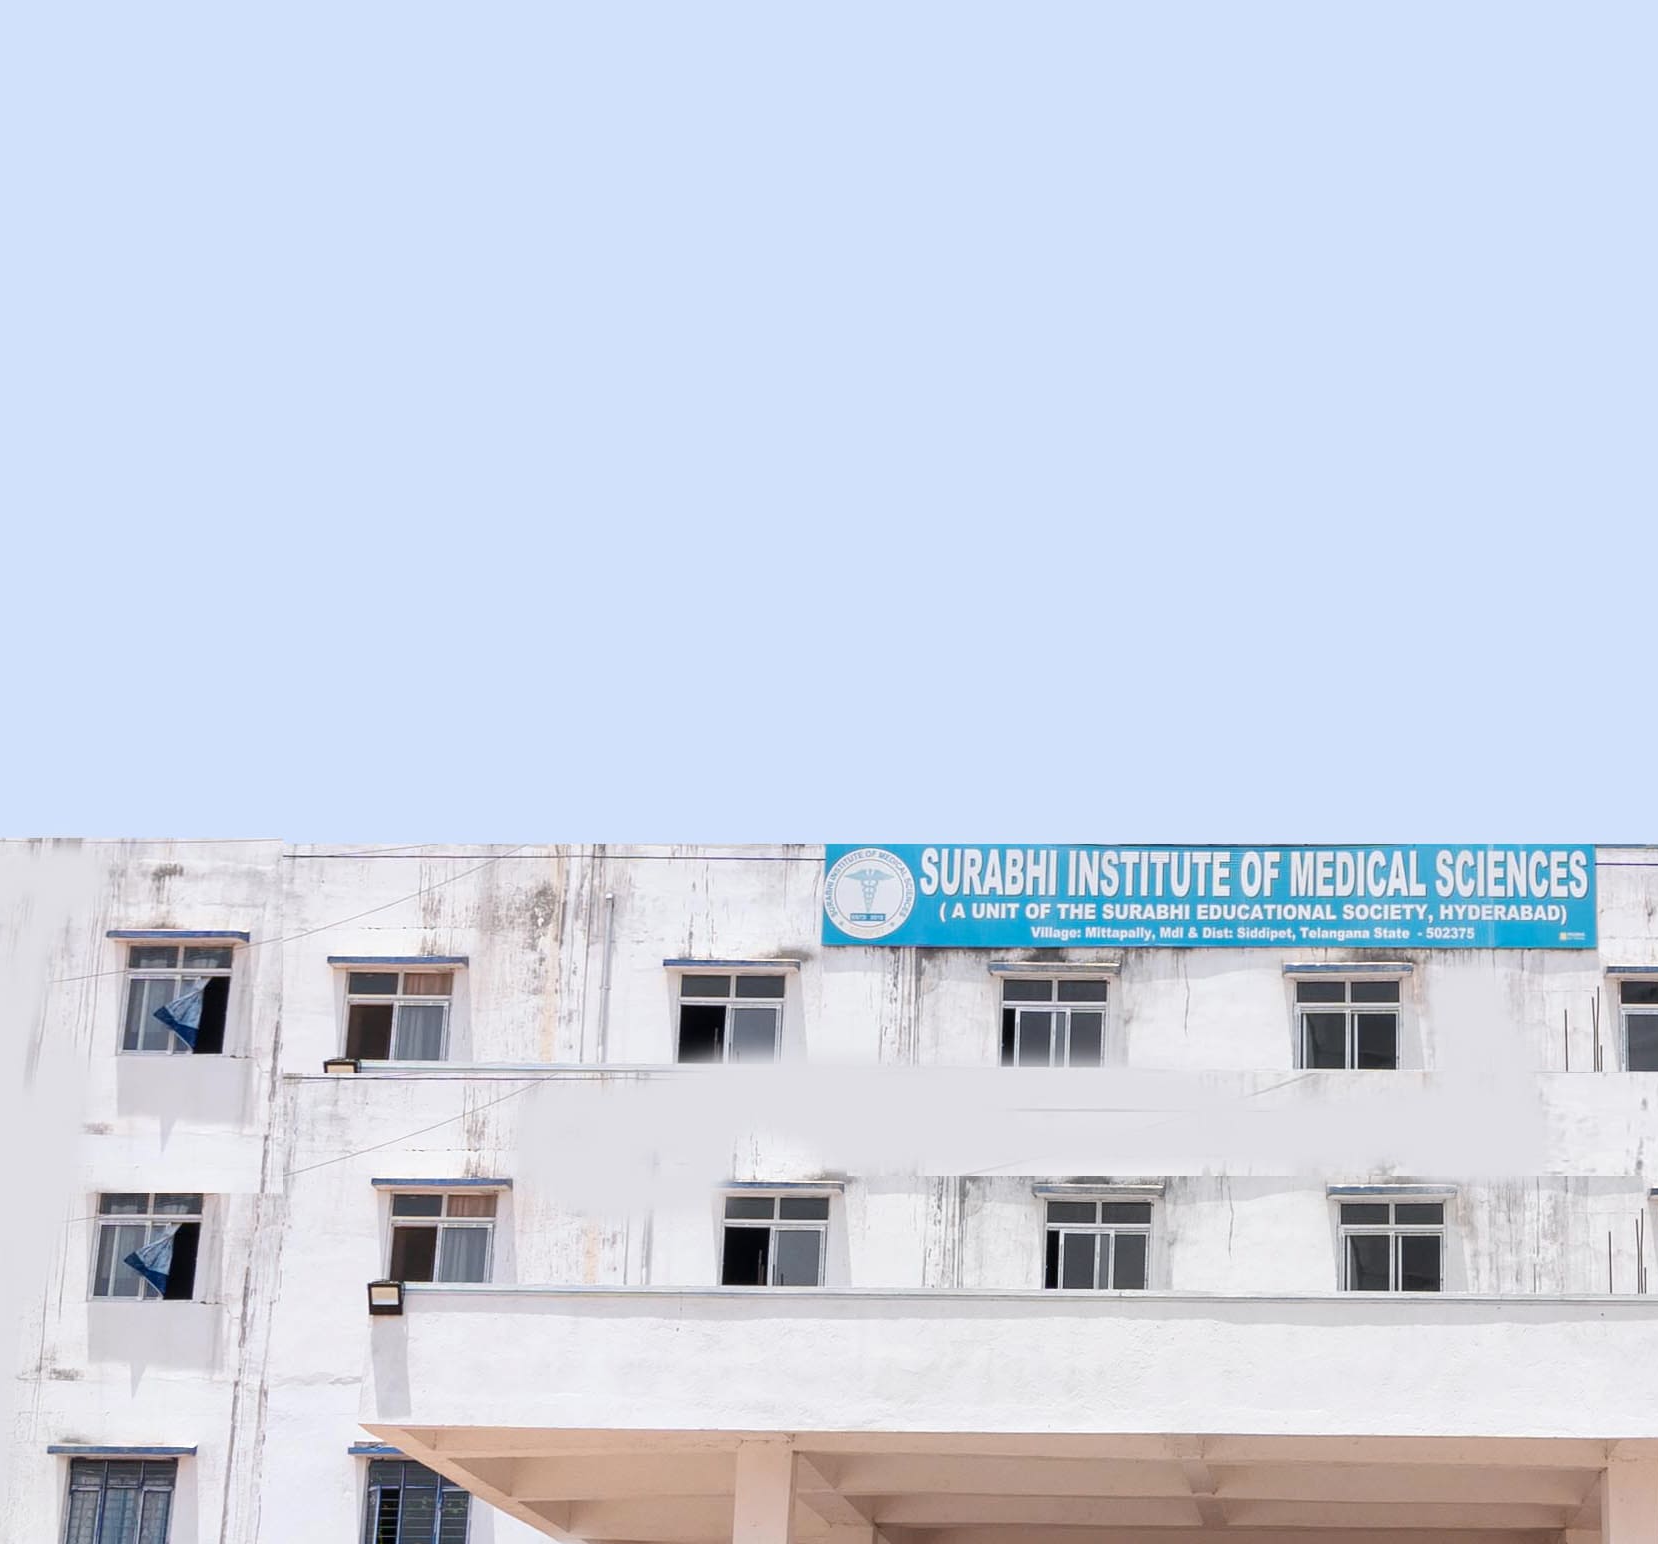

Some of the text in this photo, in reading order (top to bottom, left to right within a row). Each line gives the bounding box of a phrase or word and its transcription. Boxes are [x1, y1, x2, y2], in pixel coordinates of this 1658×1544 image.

[919, 848, 1588, 899] SURABHI INSTITUTE OF MEDICAL SCIENCES
[971, 903, 1020, 919] UNIT
[1024, 903, 1052, 920] OF
[1056, 904, 1097, 920] THE
[1102, 904, 1191, 920] SURABHI
[1196, 904, 1338, 921] EDUCATIONAL
[1342, 904, 1434, 924] SOCIETY,
[1439, 904, 1568, 924] HYDERABAD)
[1030, 927, 1081, 941] Village:
[1085, 927, 1156, 942] Mittapally,
[1159, 927, 1184, 939] Mdl
[1187, 927, 1198, 939] &
[1202, 927, 1233, 939] Dist:
[1236, 927, 1296, 941] Siddipet,
[1299, 927, 1371, 942] Telangana
[1373, 927, 1411, 939] State
[1425, 927, 1475, 940] 502375
